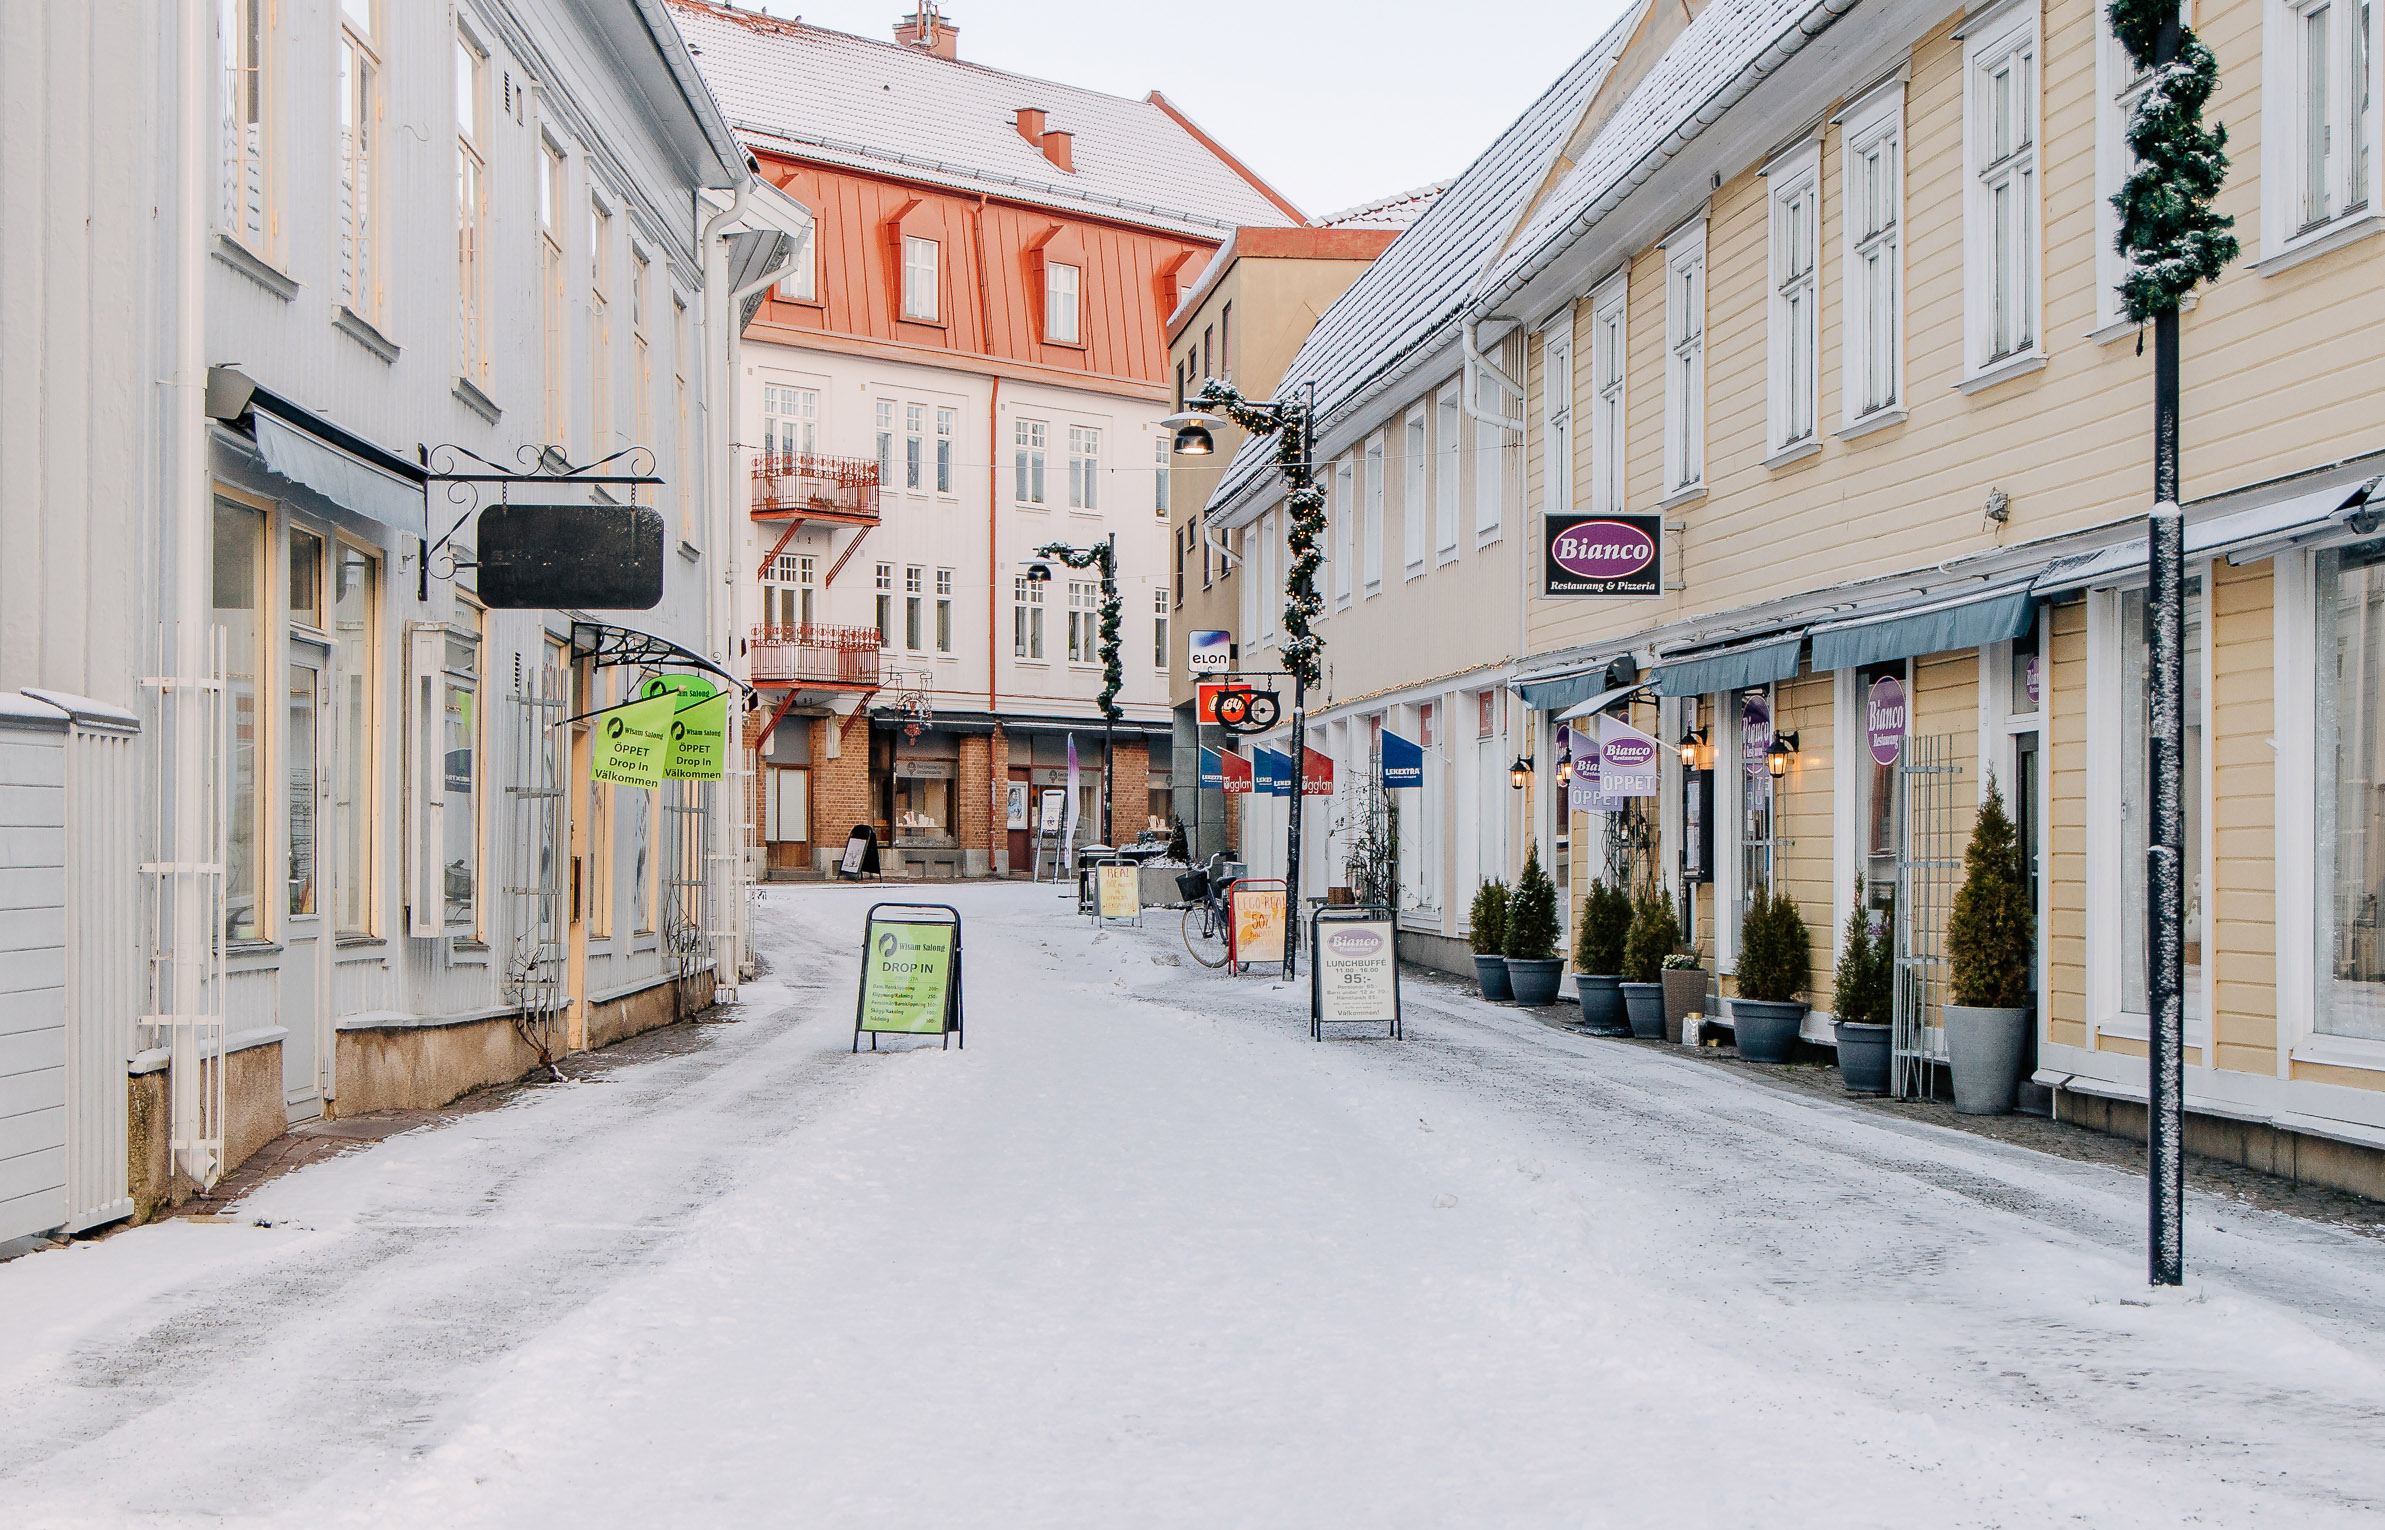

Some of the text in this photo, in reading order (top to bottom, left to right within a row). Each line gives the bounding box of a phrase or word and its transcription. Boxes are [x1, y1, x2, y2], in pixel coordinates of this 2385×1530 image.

[1559, 538, 1649, 560] Bianco
[1551, 582, 1655, 592] Restaurang & Pizzeria
[1868, 700, 1904, 732] Bianco
[644, 730, 664, 740] Salong
[679, 742, 710, 753] ÖPPET
[1873, 734, 1898, 750] Restaurang
[614, 741, 650, 757] ÖPPET
[1606, 744, 1650, 756] Bianco
[609, 756, 648, 771] Drop In
[676, 756, 712, 766] Drop In
[1576, 760, 1600, 770] Bia
[595, 768, 658, 788] Välkommen
[665, 768, 721, 778] Välkommen
[1603, 772, 1654, 791] ÖPPET
[1107, 868, 1129, 878] REA!
[1252, 913, 1272, 929] 50%
[1333, 936, 1378, 946] Bianco
[900, 942, 946, 952] Wisam Salong
[882, 962, 934, 973] DROP IN
[1326, 958, 1386, 967] LUNCHBUFFÉ
[1344, 974, 1372, 984] 95:-
